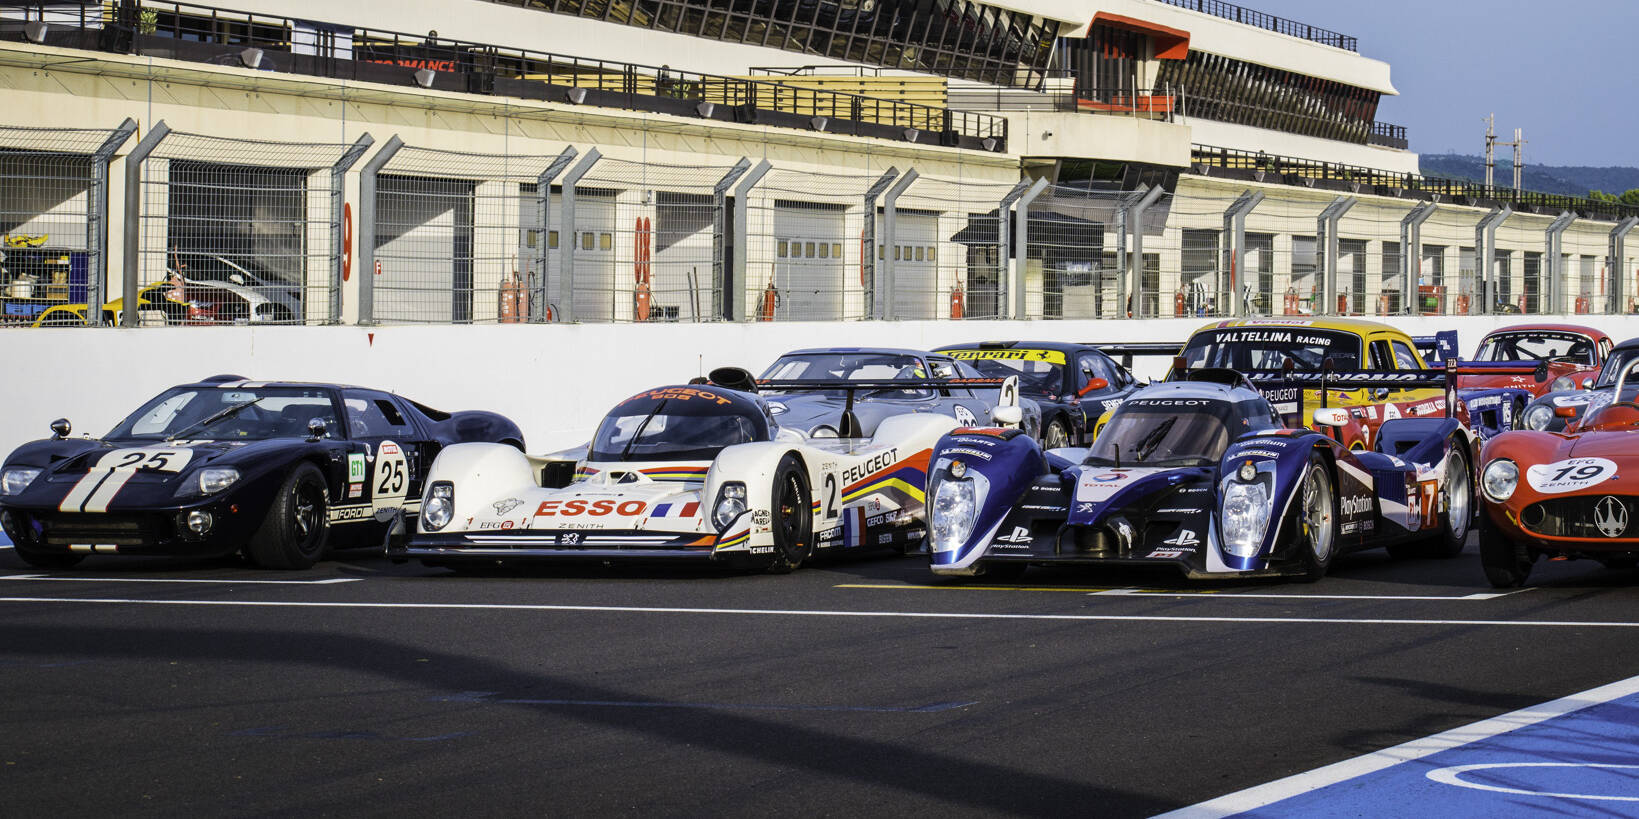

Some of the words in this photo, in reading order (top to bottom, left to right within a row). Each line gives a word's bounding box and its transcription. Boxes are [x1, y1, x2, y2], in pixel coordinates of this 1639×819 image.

[1215, 331, 1292, 343] VALTELLINA
[1296, 335, 1332, 346] RACING
[948, 351, 1029, 360] Ferrari
[619, 388, 732, 405] PEUGEOT
[1264, 388, 1298, 401] PEUGEOT
[116, 452, 176, 469] 25
[352, 460, 363, 476] GT1
[842, 448, 898, 486] PEUGEOT
[377, 460, 404, 494] 25
[1551, 465, 1604, 481] 19
[825, 473, 838, 519] 2
[339, 508, 364, 519] FORD
[535, 500, 648, 517] ESSO
[1341, 494, 1373, 521] PlayStation
[1424, 484, 1436, 526] 7
